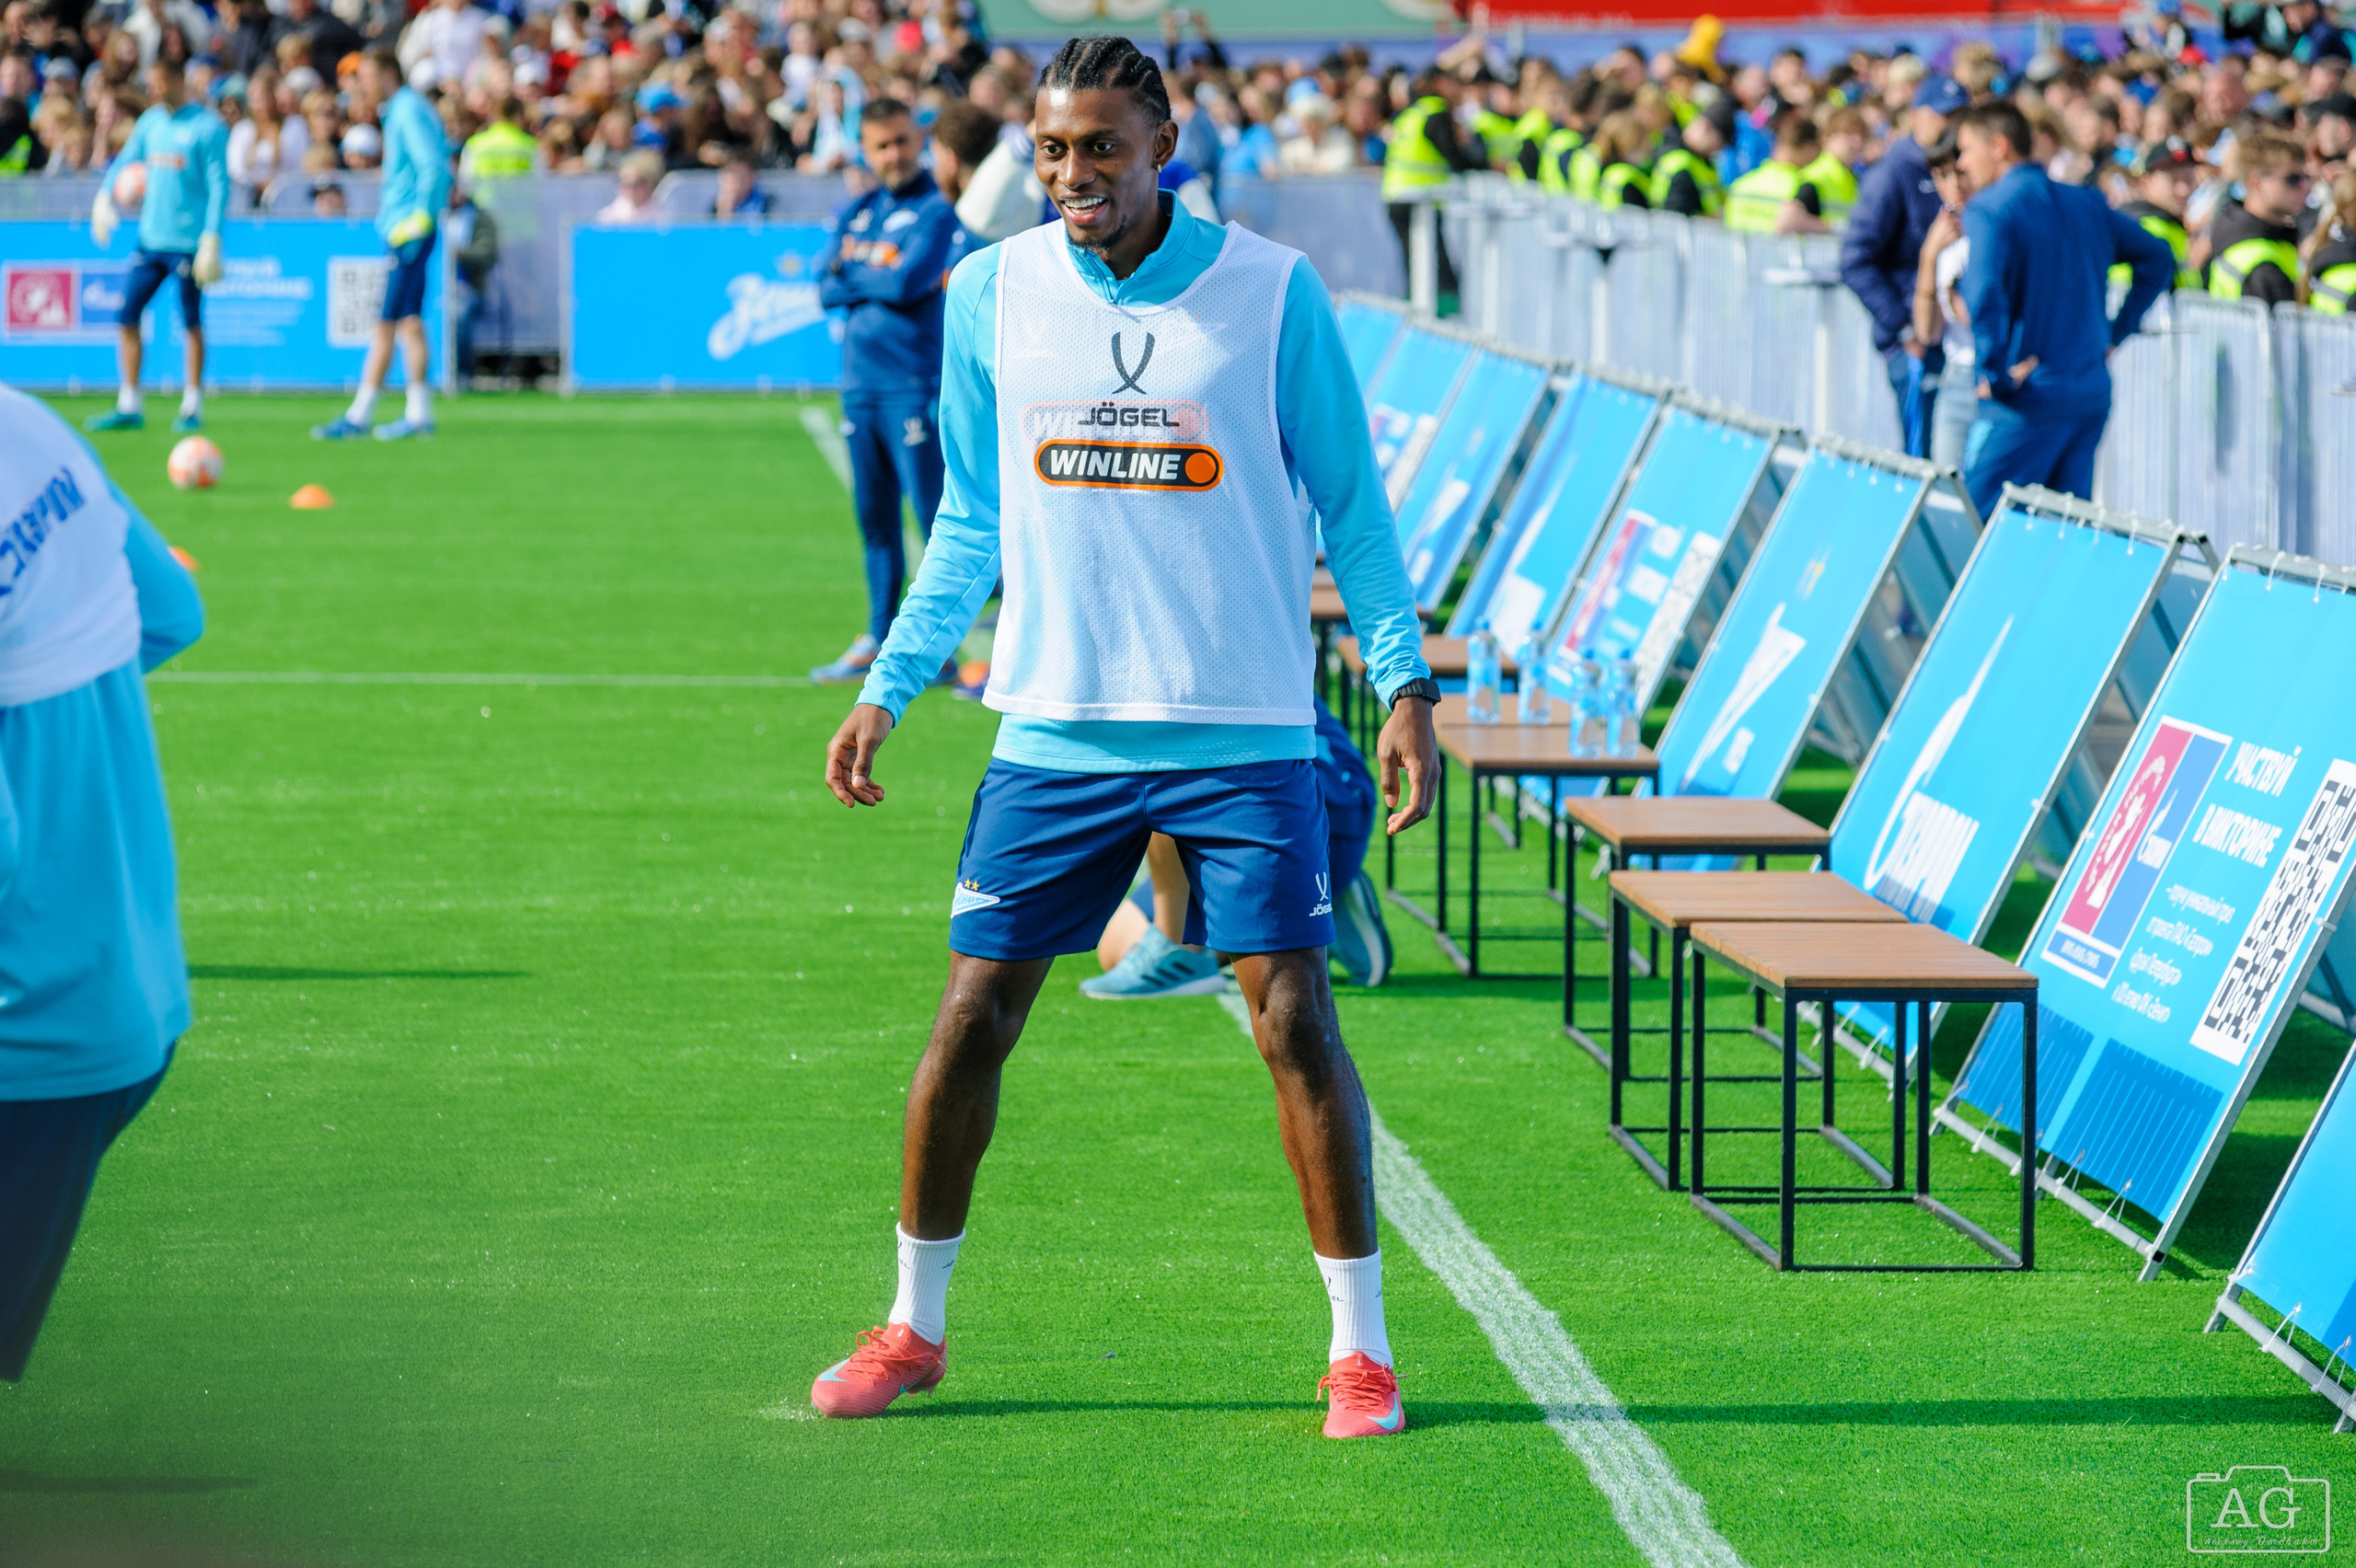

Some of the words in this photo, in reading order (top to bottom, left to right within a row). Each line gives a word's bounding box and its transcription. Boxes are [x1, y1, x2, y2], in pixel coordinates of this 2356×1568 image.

[1078, 401, 1180, 427] JÖGEL
[1050, 449, 1181, 480] WINLINE
[2224, 742, 2303, 798] УЧАСТВУЙ
[2192, 803, 2216, 843] В
[2200, 806, 2282, 868] ВИКТОРИНЕ
